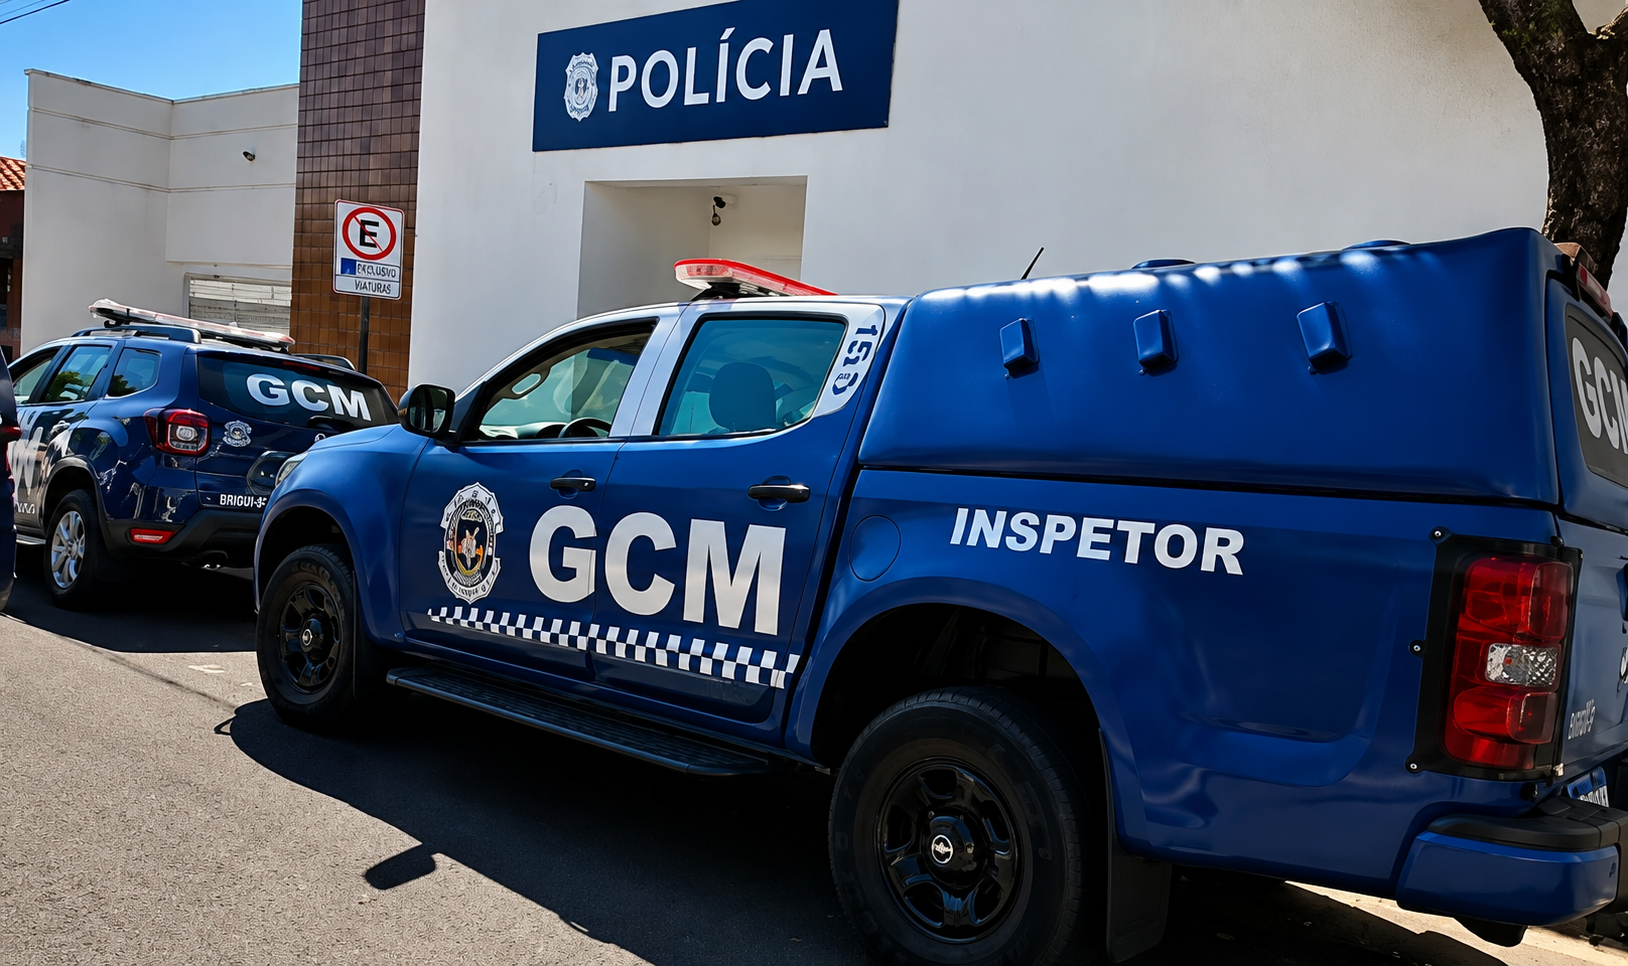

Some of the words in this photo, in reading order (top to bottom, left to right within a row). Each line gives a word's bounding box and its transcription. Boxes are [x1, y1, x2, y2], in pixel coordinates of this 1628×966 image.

[608, 27, 843, 112] POLÍCIA
[359, 219, 380, 248] E
[354, 279, 391, 294] VIATURAS
[246, 373, 372, 422] GCM
[1572, 337, 1628, 455] GCM
[529, 504, 787, 636] GCM
[950, 507, 1244, 576] INSPETOR
